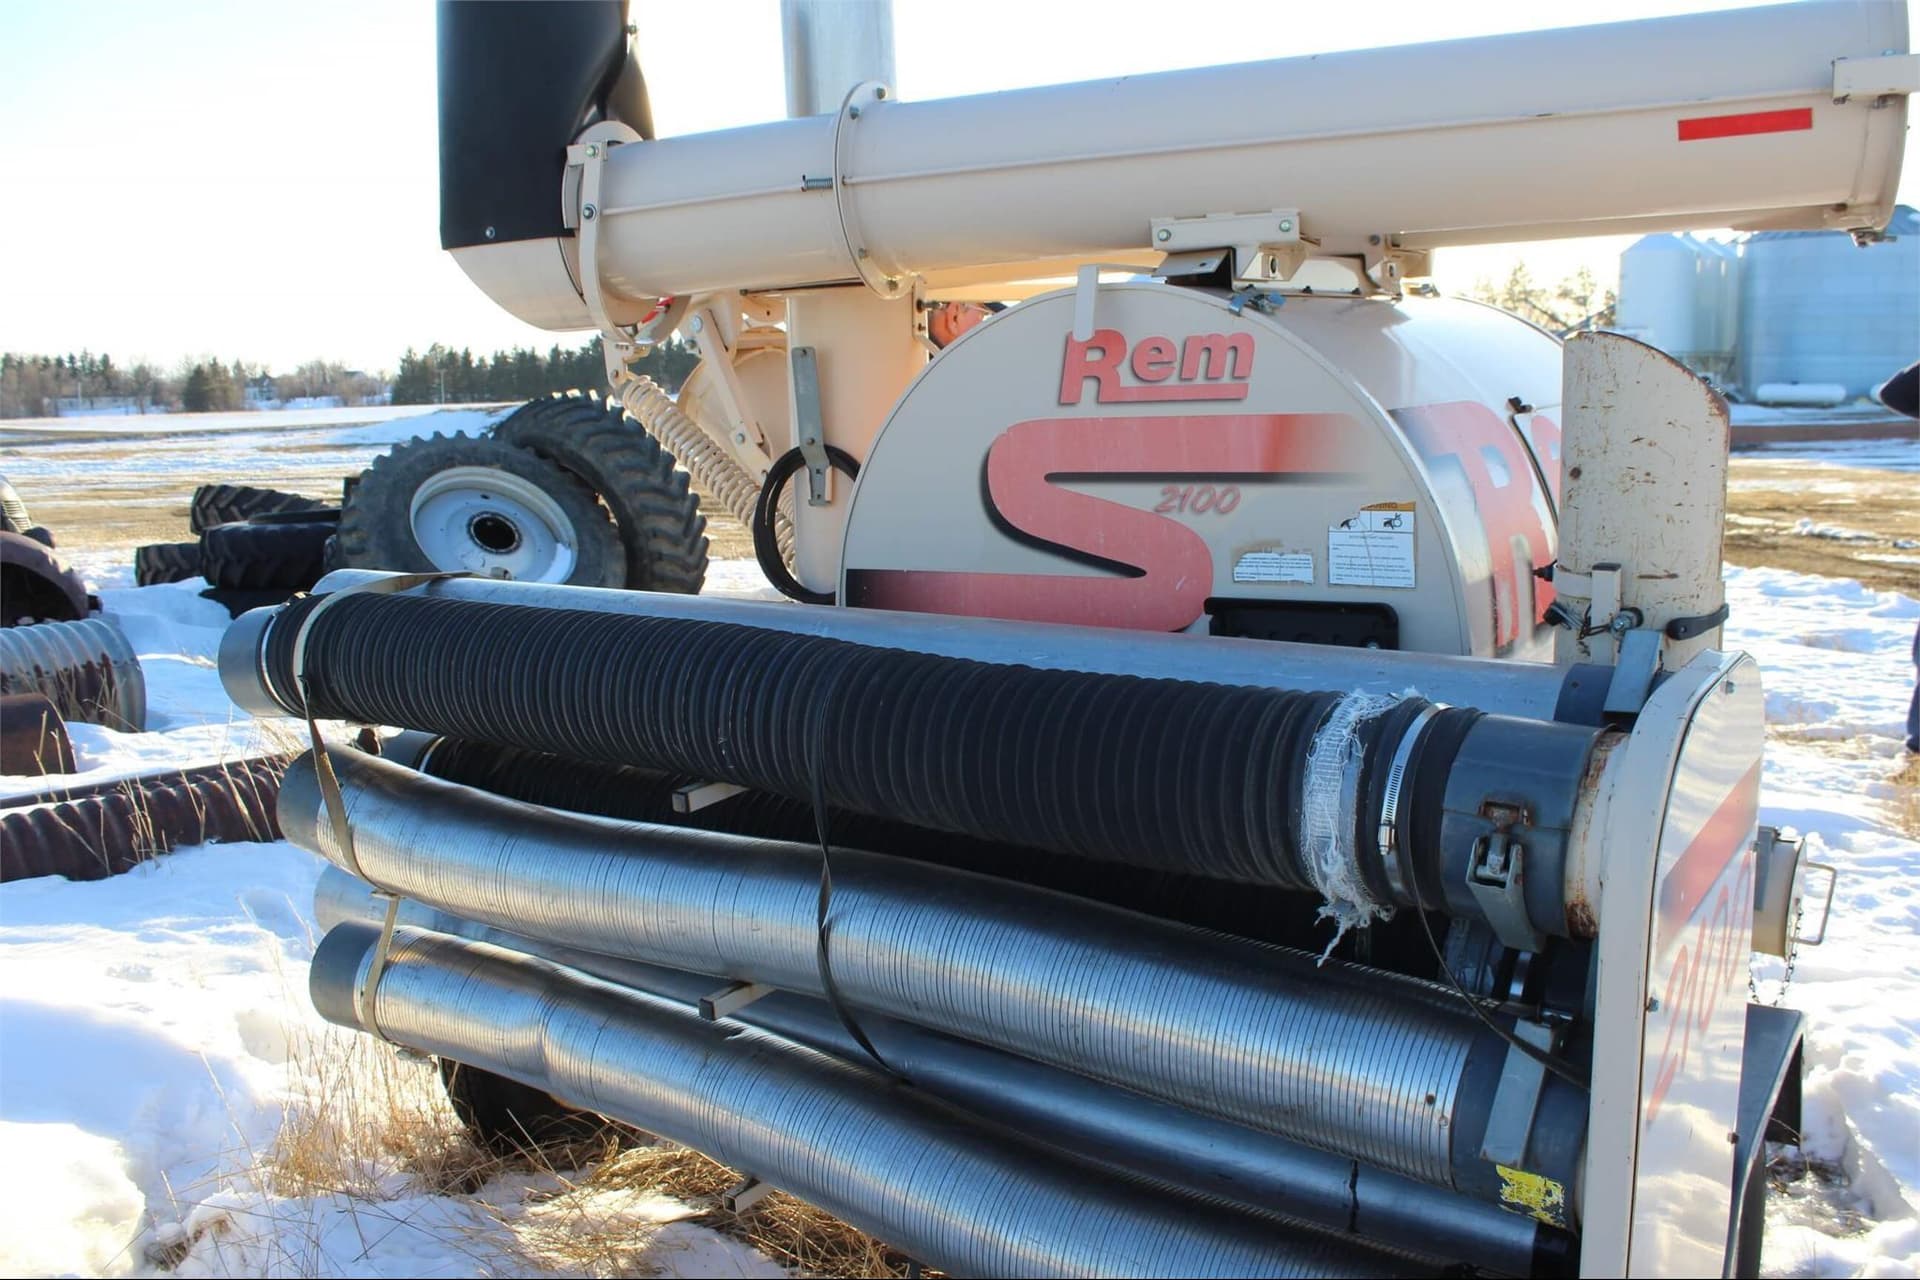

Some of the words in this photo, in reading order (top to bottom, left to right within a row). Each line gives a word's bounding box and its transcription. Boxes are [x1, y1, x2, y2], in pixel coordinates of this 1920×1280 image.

[1058, 328, 1254, 405] Rem
[1154, 483, 1242, 514] 2100
[1646, 848, 1752, 1122] 2100
